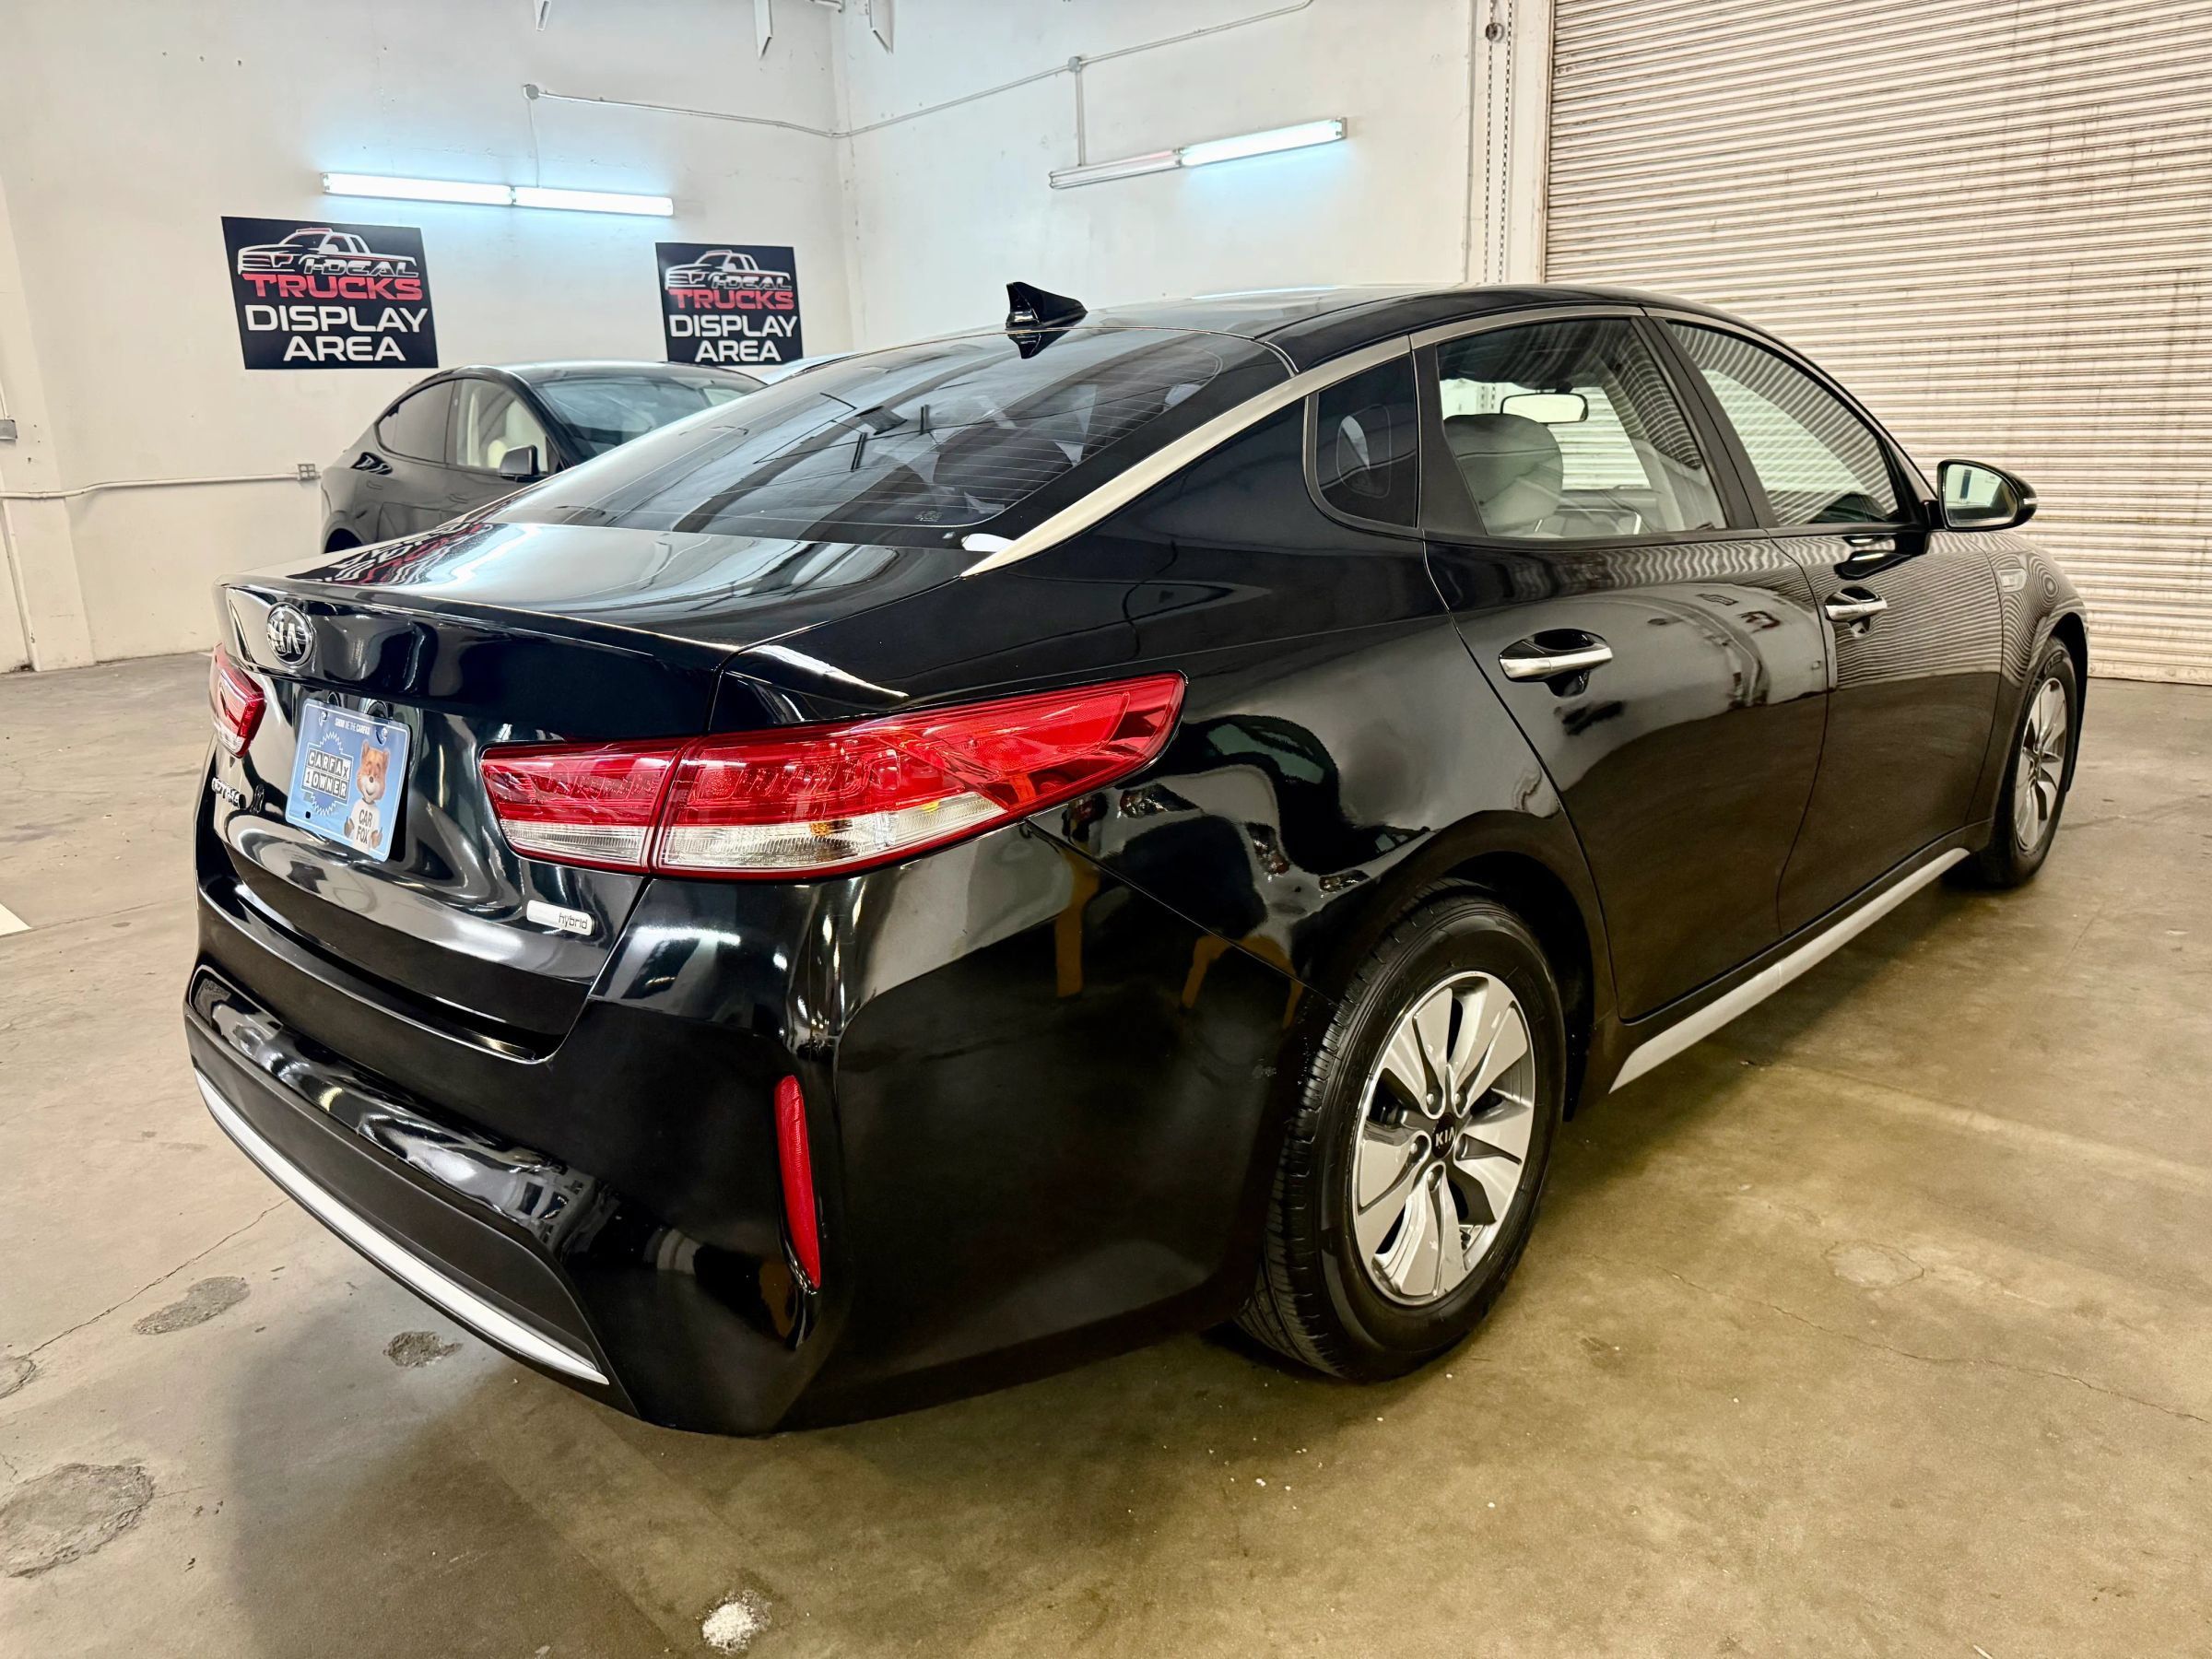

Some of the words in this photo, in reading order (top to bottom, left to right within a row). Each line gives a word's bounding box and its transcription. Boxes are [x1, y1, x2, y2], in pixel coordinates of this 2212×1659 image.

[241, 273, 423, 300] TRUCKS
[668, 288, 794, 310] TRUCKS
[244, 305, 428, 333] DISPLAY
[669, 314, 798, 337] DISPLAY
[283, 335, 406, 361] AREA
[695, 340, 782, 362] AREA
[309, 751, 349, 779] CARFAX
[312, 772, 347, 797] OWNER
[359, 808, 373, 828] CAR
[357, 825, 370, 844] FOX
[558, 912, 588, 930] hybrid
[1435, 1126, 1455, 1147] KIA
